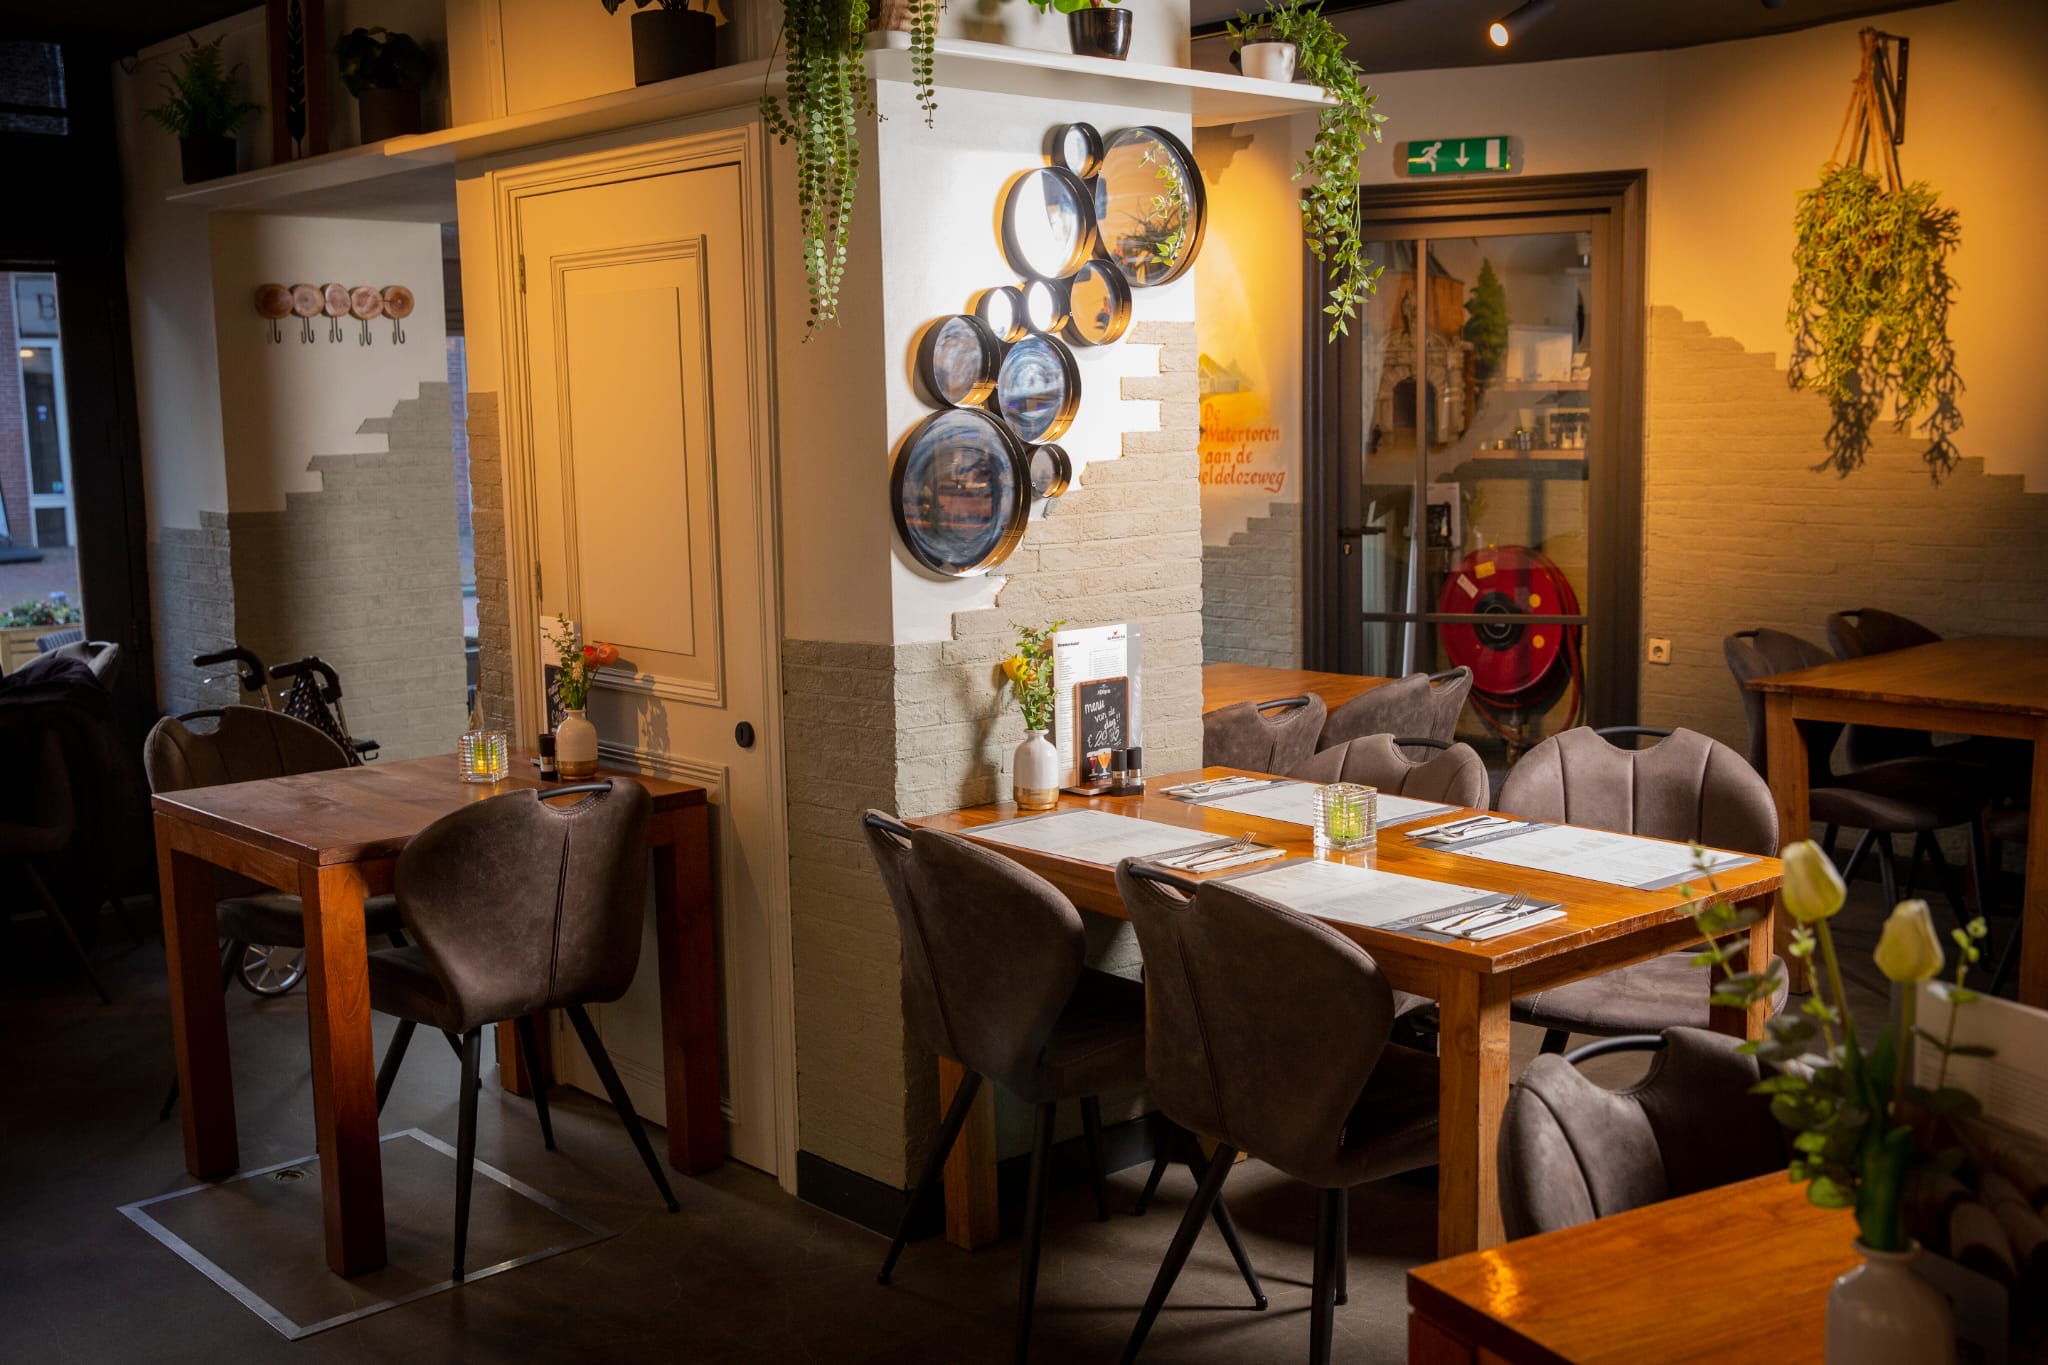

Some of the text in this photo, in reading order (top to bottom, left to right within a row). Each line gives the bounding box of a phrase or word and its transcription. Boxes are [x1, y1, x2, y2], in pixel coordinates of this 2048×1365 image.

[1203, 422, 1280, 442] Watertoren
[1205, 443, 1253, 464] aan de
[1198, 464, 1285, 493] eldelozeweg
[1085, 700, 1105, 714] menu
[1094, 706, 1116, 723] van de
